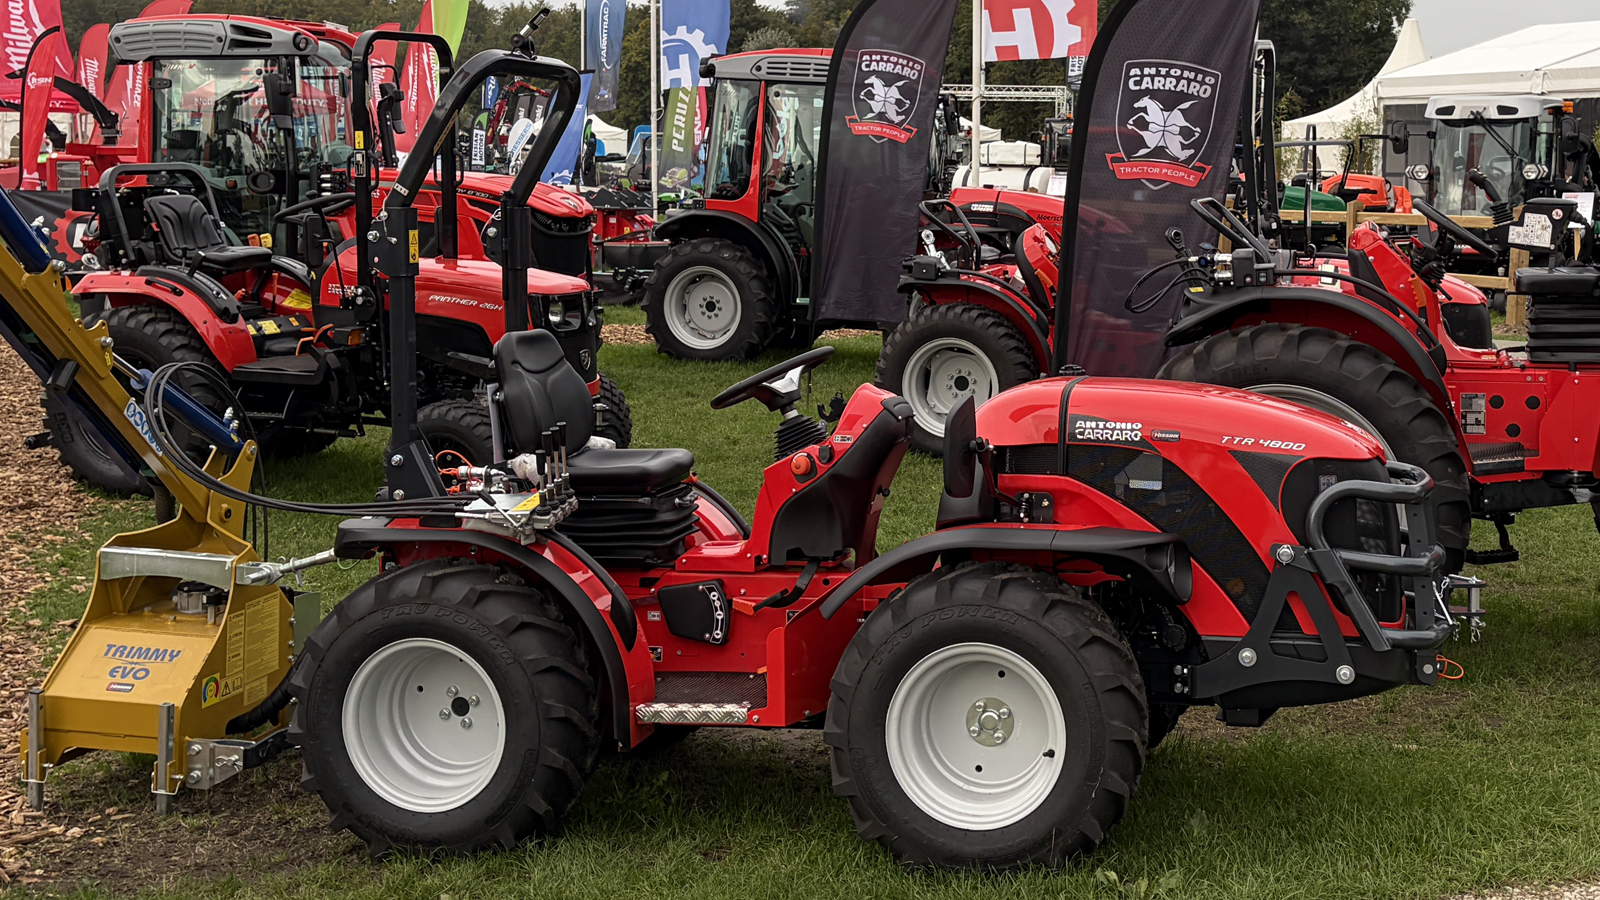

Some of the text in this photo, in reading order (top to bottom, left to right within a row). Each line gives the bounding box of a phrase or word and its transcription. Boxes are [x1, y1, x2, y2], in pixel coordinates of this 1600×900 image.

[601, 7, 609, 62] FARMTRAC
[861, 62, 919, 80] CARRARO
[862, 55, 921, 70] ANTONIO
[1129, 67, 1216, 84] ANTONIO
[1128, 77, 1212, 98] CARRARO
[882, 127, 906, 139] PEOPLE
[1119, 166, 1196, 182] TRACTOR PEOPLE
[428, 294, 504, 311] PANTHER 26H
[1075, 420, 1143, 430] ANTONIO
[1074, 428, 1143, 442] CARRARO
[1221, 435, 1307, 451] TTR 4800
[921, 605, 1019, 628] POWER
[380, 603, 516, 666] TRU POWER
[103, 643, 182, 663] TRIMMY
[108, 665, 151, 681] EVO
